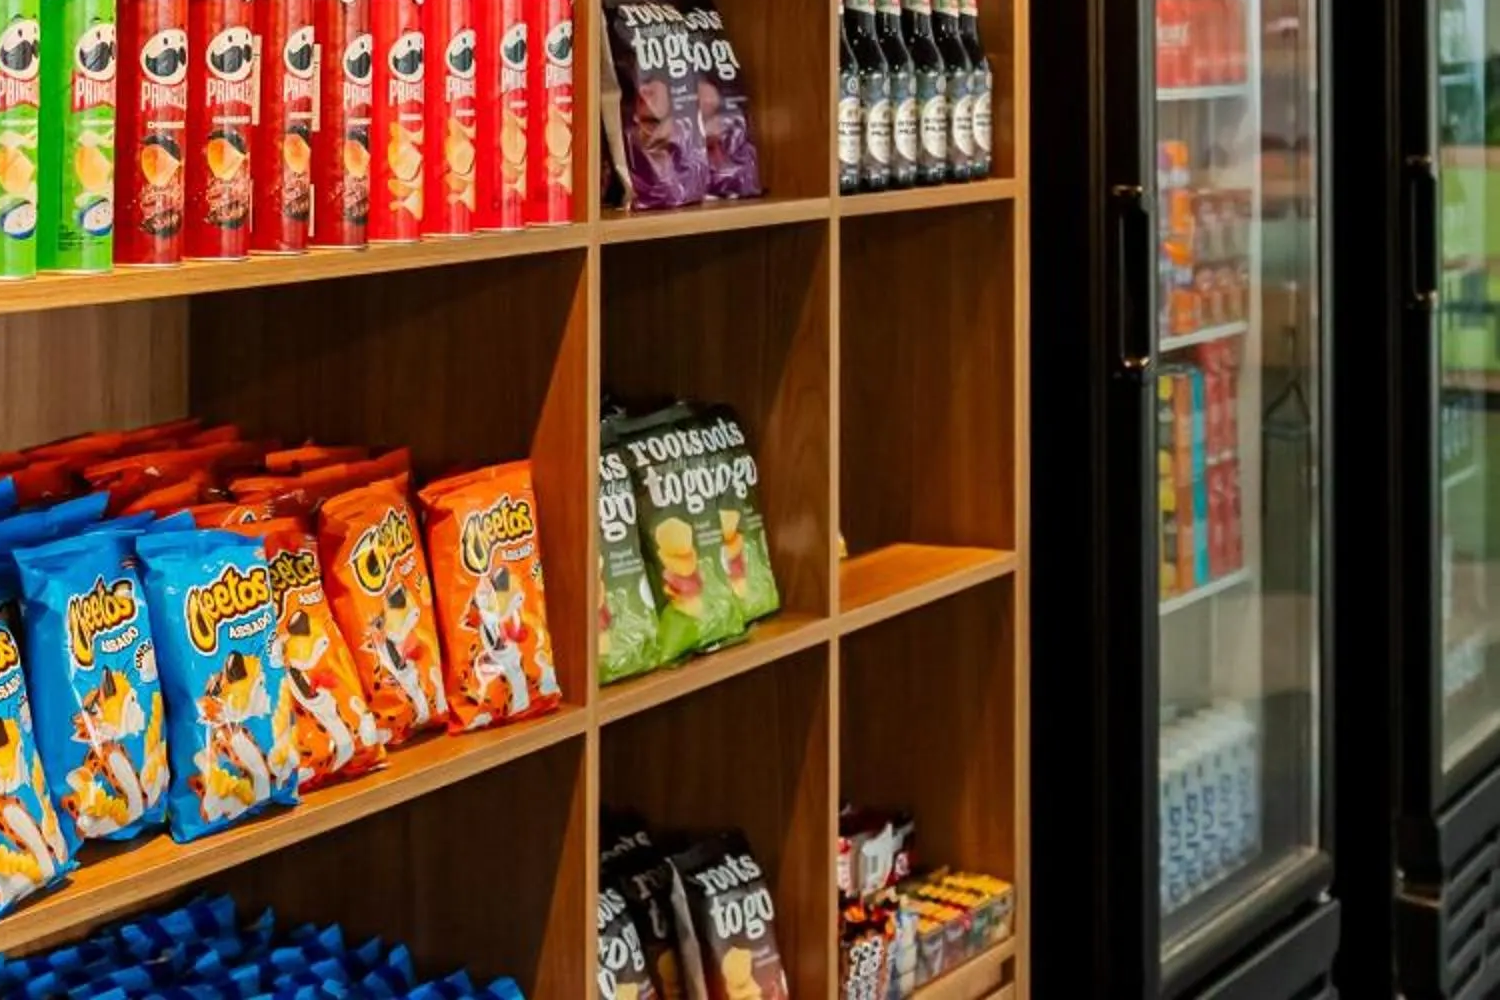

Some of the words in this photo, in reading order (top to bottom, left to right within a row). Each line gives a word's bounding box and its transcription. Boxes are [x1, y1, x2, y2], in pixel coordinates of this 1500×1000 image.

[701, 417, 745, 451] oots
[643, 465, 714, 514] togo
[715, 455, 757, 499] ogo
[69, 575, 136, 668] Cheetos
[186, 565, 272, 654] Cheetos
[695, 853, 762, 897] roots
[709, 888, 774, 940] togo
